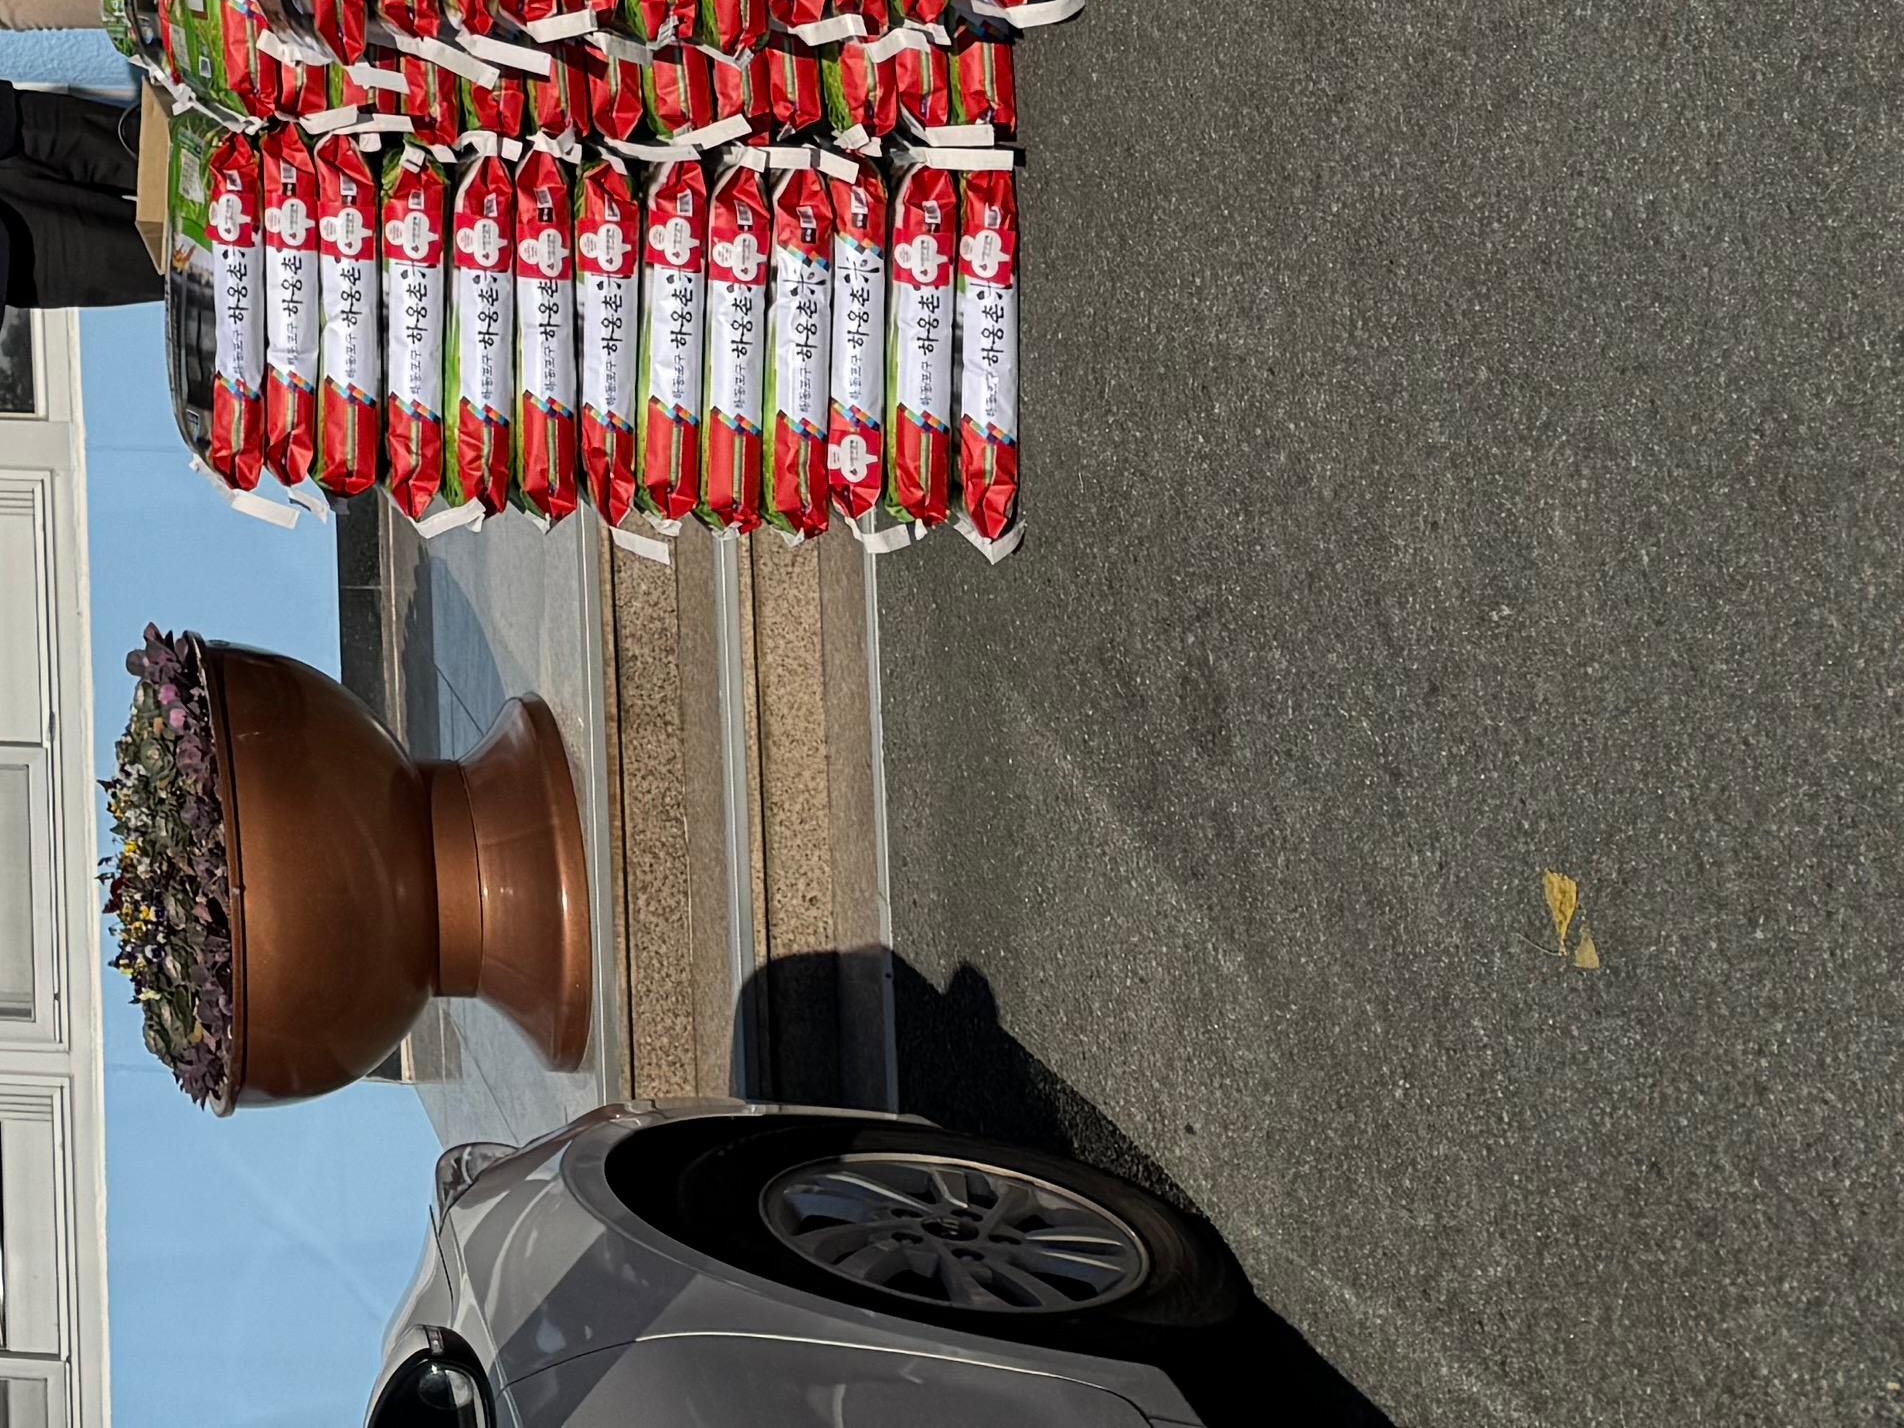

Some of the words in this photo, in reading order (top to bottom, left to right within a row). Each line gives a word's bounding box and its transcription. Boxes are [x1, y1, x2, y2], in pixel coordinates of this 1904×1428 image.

[227, 262, 248, 324] 하옹촌
[281, 256, 303, 317] 하옹촌
[340, 267, 362, 327] 하옹촌
[406, 283, 428, 344] 하옹촌
[540, 279, 561, 341] 하옹촌
[478, 287, 499, 349] 하옹촌
[601, 294, 623, 356] 하옹촌
[671, 287, 693, 349] 하옹촌
[731, 297, 753, 358] 하옹촌
[795, 299, 818, 362] 하옹촌
[847, 287, 869, 349] 하옹촌
[917, 294, 940, 355] 하옹촌
[981, 304, 1004, 366] 하옹촌
